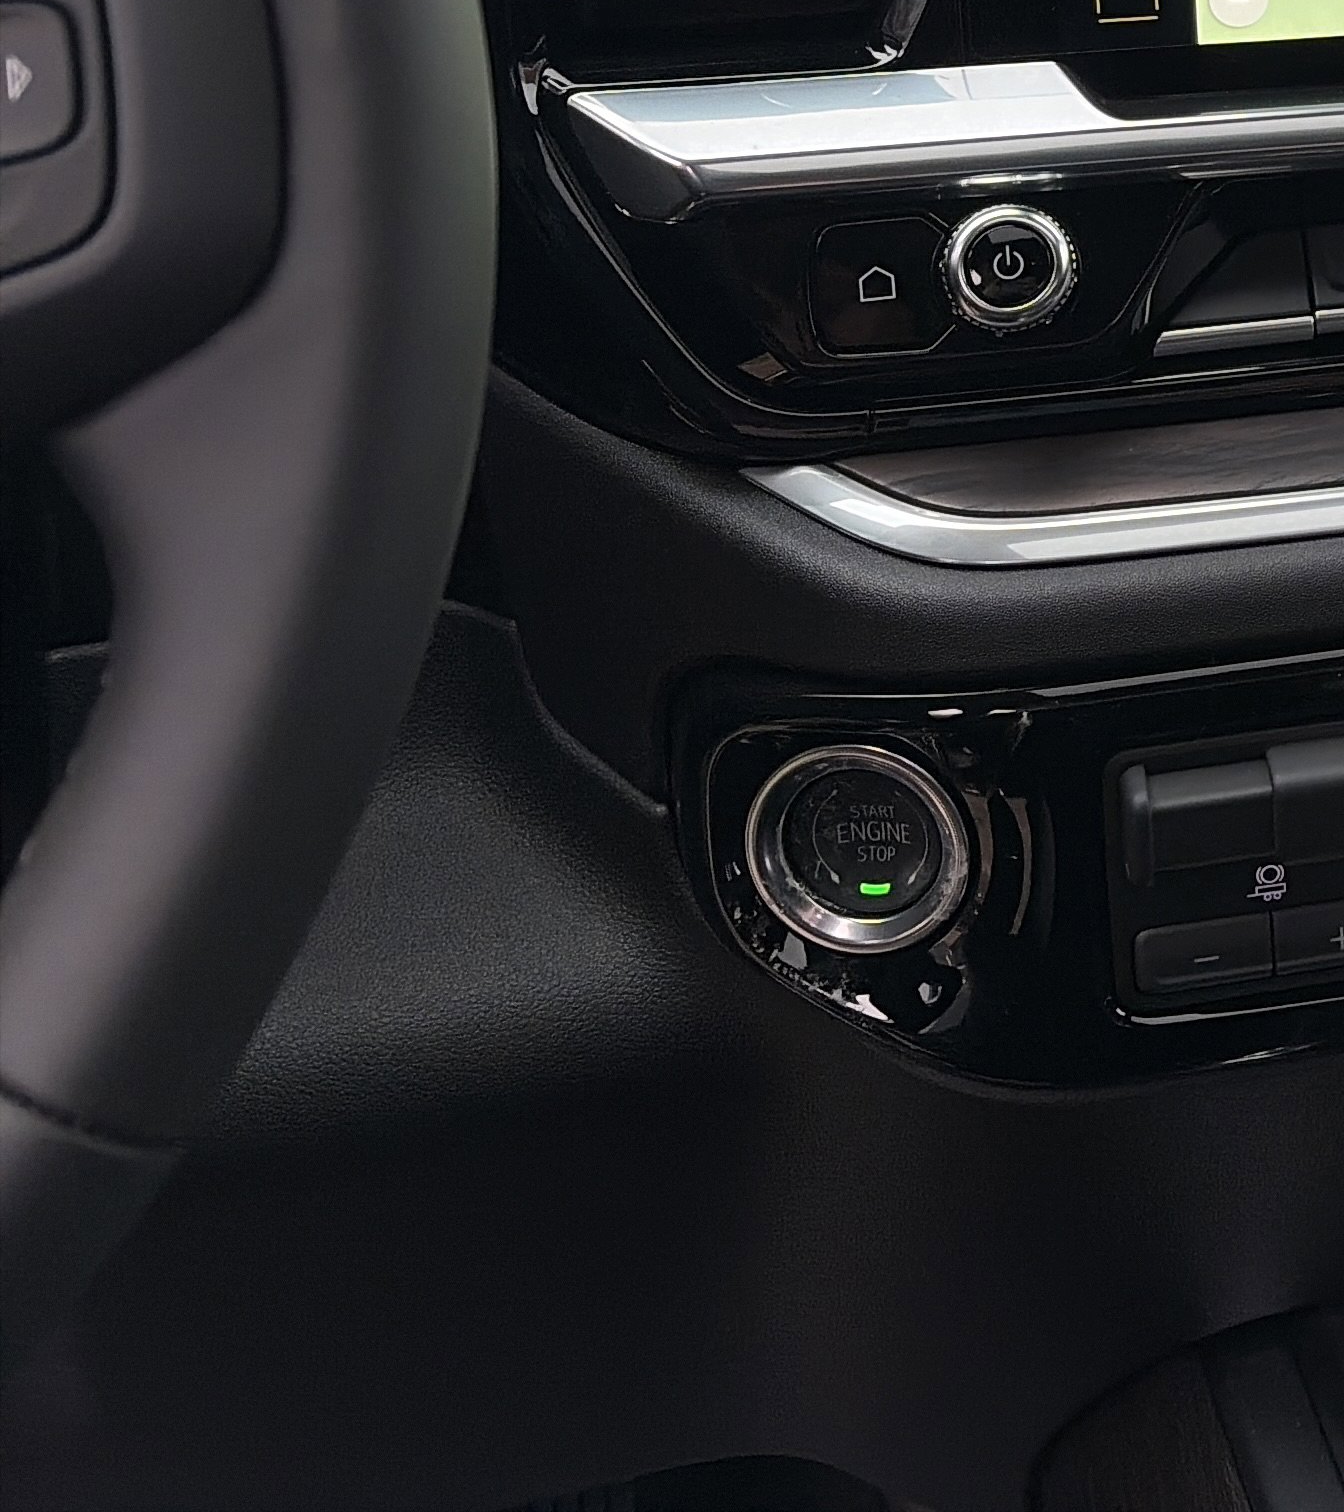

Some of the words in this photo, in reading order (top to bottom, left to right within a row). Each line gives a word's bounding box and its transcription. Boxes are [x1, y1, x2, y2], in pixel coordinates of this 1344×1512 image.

[849, 804, 895, 819] START
[836, 820, 911, 845] ENGINE
[857, 845, 896, 863] STOP
